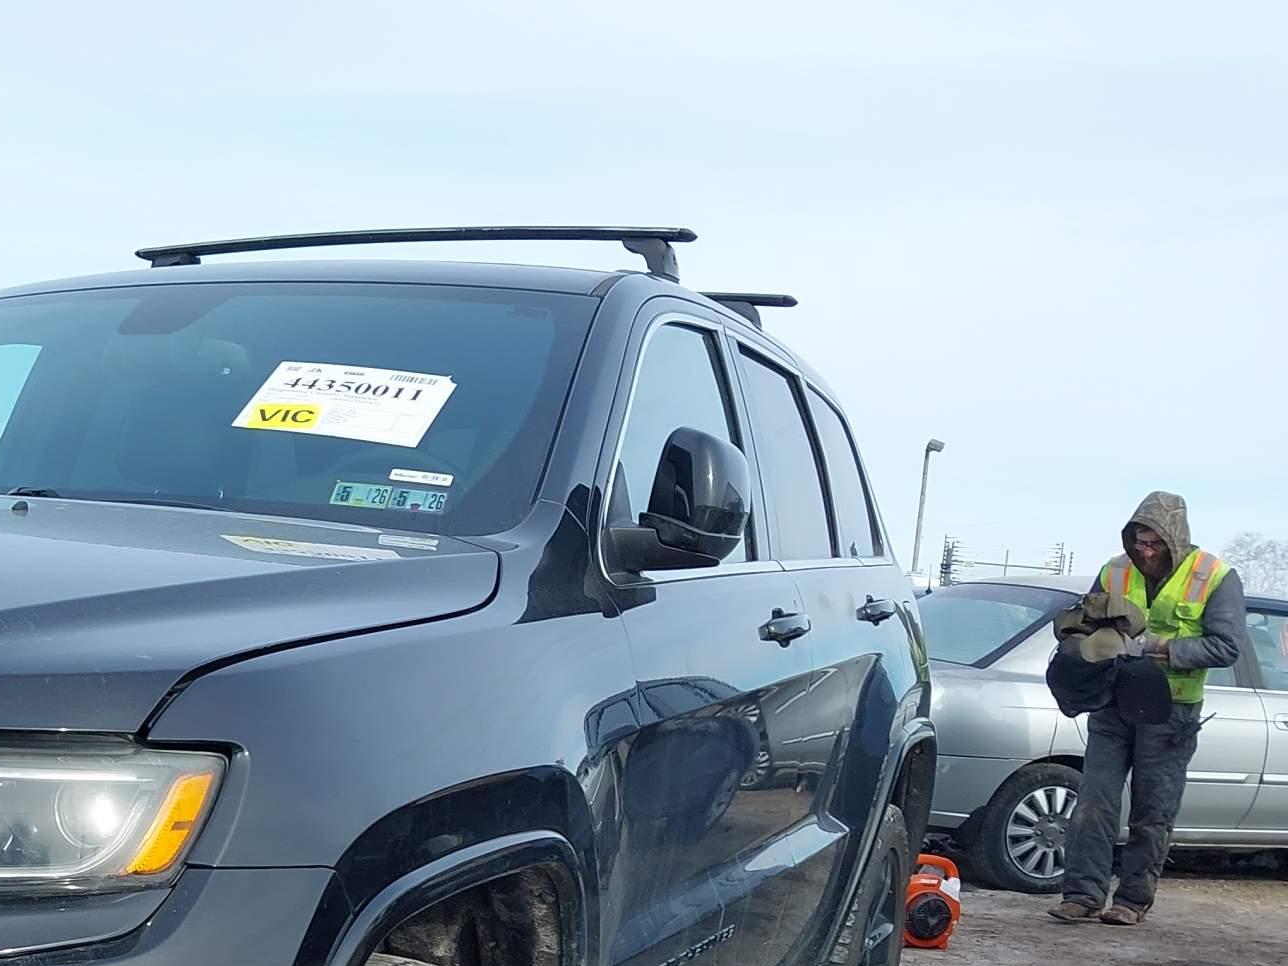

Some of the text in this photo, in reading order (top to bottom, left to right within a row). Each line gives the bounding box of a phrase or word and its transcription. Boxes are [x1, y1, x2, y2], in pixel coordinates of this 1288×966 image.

[284, 377, 423, 401] 44350011
[258, 408, 315, 424] VIC
[372, 488, 389, 505] 26
[428, 493, 446, 510] 26
